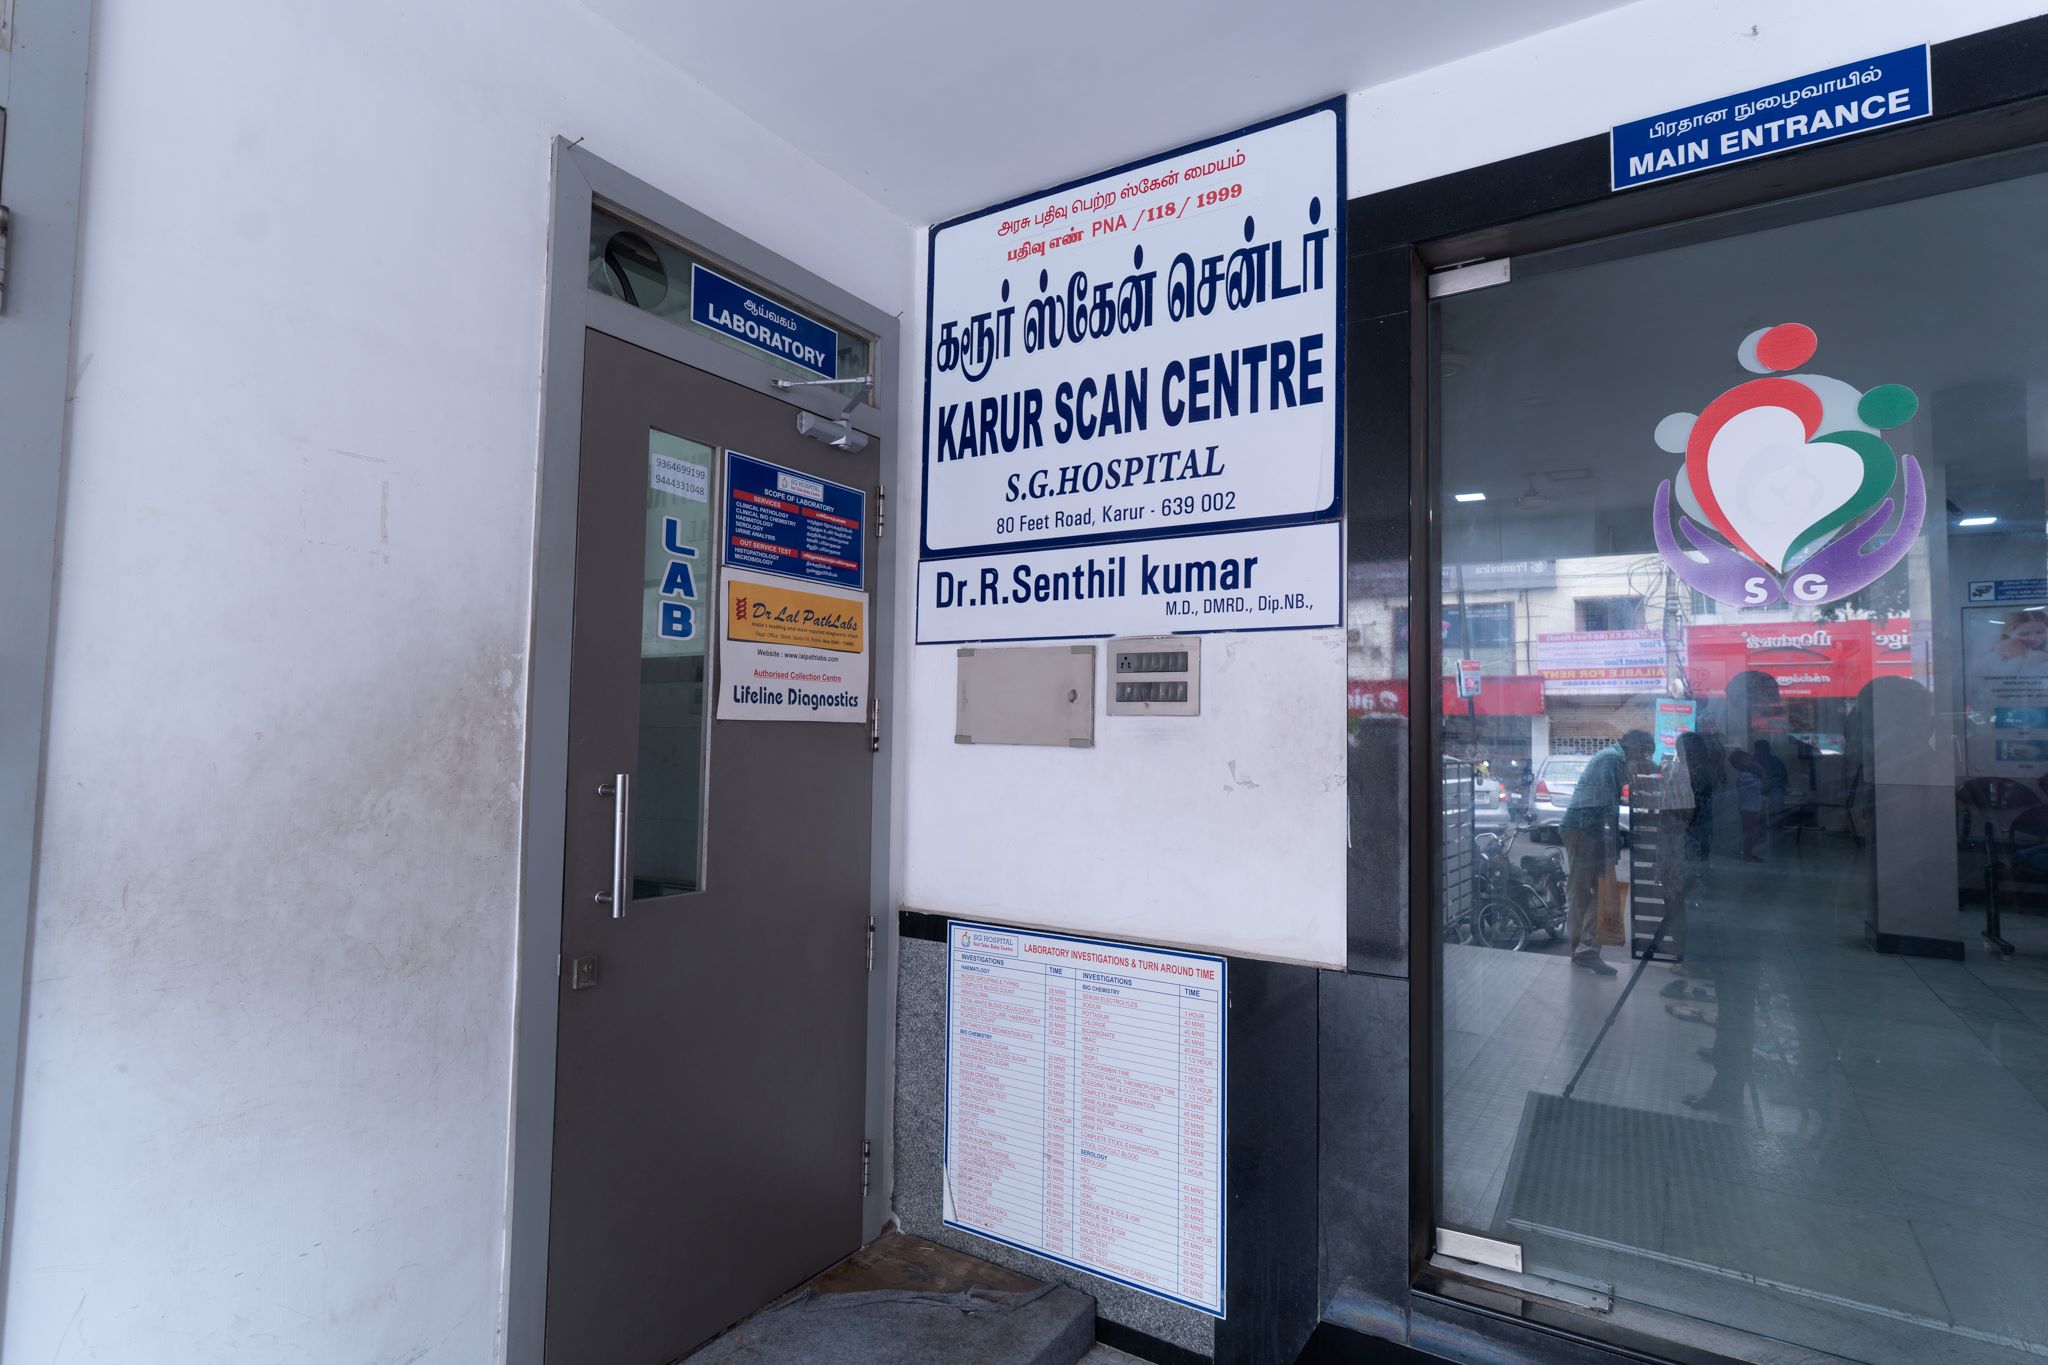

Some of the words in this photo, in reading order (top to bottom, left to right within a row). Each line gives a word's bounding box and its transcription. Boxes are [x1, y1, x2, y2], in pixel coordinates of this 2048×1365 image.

[1649, 108, 1728, 138] பிரதான
[1734, 65, 1881, 121] நுழைவாயில்
[1629, 138, 1708, 177] MAIN
[1720, 87, 1910, 155] ENTRANCE
[997, 216, 1030, 236] அரசு
[1034, 205, 1067, 228] பதிவு
[1071, 191, 1116, 213] பெற்ற
[1120, 169, 1179, 199] ஸ்கேன்
[1183, 148, 1245, 180] மையம்
[1007, 240, 1045, 261] பதிவு
[1048, 226, 1084, 248] எண்
[1092, 214, 1127, 237] PNA
[1196, 183, 1242, 208] 1999
[936, 278, 1015, 382] கரூர்
[1023, 244, 1156, 353] ஸ்கேன்
[1167, 196, 1329, 322] சென்டர்
[743, 299, 796, 330] ஆய்வகம்
[708, 302, 825, 367] LABORATORY
[937, 388, 1043, 462] KARUR
[1054, 366, 1147, 444] SCAN
[1161, 333, 1323, 426] CENTRE
[656, 457, 705, 479] 9364699199
[655, 474, 704, 495] 9444331048
[735, 500, 758, 511] CLINICAL
[759, 506, 788, 519] PATHOLOGY
[753, 495, 780, 508] SERVICES
[764, 488, 785, 500] SCOPE
[786, 494, 794, 502] OF
[796, 497, 834, 513] LABORATORY
[735, 507, 758, 518] CLINICAL
[769, 515, 796, 527] CHEMISTRY
[735, 514, 773, 527] HAEMATOLOGY
[996, 516, 1014, 534] 80
[1019, 514, 1049, 531] Feet
[1055, 507, 1095, 527] Road,
[1102, 504, 1144, 522] Karur
[1161, 495, 1194, 516] 639
[1201, 491, 1235, 512] 002
[735, 520, 763, 532] SEROLOGY
[735, 527, 751, 535] URINE
[752, 531, 775, 541] ANALYSIS
[734, 546, 779, 560] HISTOPATHOLOGY
[739, 539, 751, 547] OUT
[753, 542, 777, 552] SERVICE
[778, 547, 791, 555] TEST
[734, 552, 772, 565] MICROBIOLOGY
[660, 516, 697, 639] LAB
[936, 556, 1125, 608] Dr.R.Senthil
[1141, 554, 1257, 595] kumar
[1744, 577, 1768, 604] S
[1793, 574, 1828, 601] G
[1165, 600, 1198, 615] M.D.,
[1203, 596, 1252, 613] DMRD.,
[1258, 593, 1312, 613] Dip.NB.,
[751, 601, 771, 620] Dr
[774, 604, 800, 623] Lal
[802, 608, 857, 631] PathLabs
[756, 648, 779, 657] Website
[753, 669, 788, 678] Authorised
[790, 671, 820, 680] Collection
[822, 674, 841, 682] Centre
[733, 684, 783, 704] Lifeline
[788, 687, 858, 711] Diagnostics
[983, 935, 1013, 945] HOSPITAL
[961, 953, 1004, 965] INVESTIGATIONS
[1024, 943, 1068, 958] LABORATORY
[1070, 950, 1128, 967] INVESTIGATIONS
[1131, 958, 1136, 968] &
[1139, 960, 1158, 971] TURN
[1160, 963, 1193, 977] AROUND
[1196, 968, 1215, 980] TIME
[1082, 972, 1132, 986] INVESTIGATIONS
[1184, 988, 1200, 997] TIME
[1092, 985, 1119, 995] CHEMISTRY
[1188, 1011, 1204, 1019] HOUR
[968, 1030, 992, 1040] CHEMISTRY
[1080, 1148, 1107, 1161] SEROLOGY
